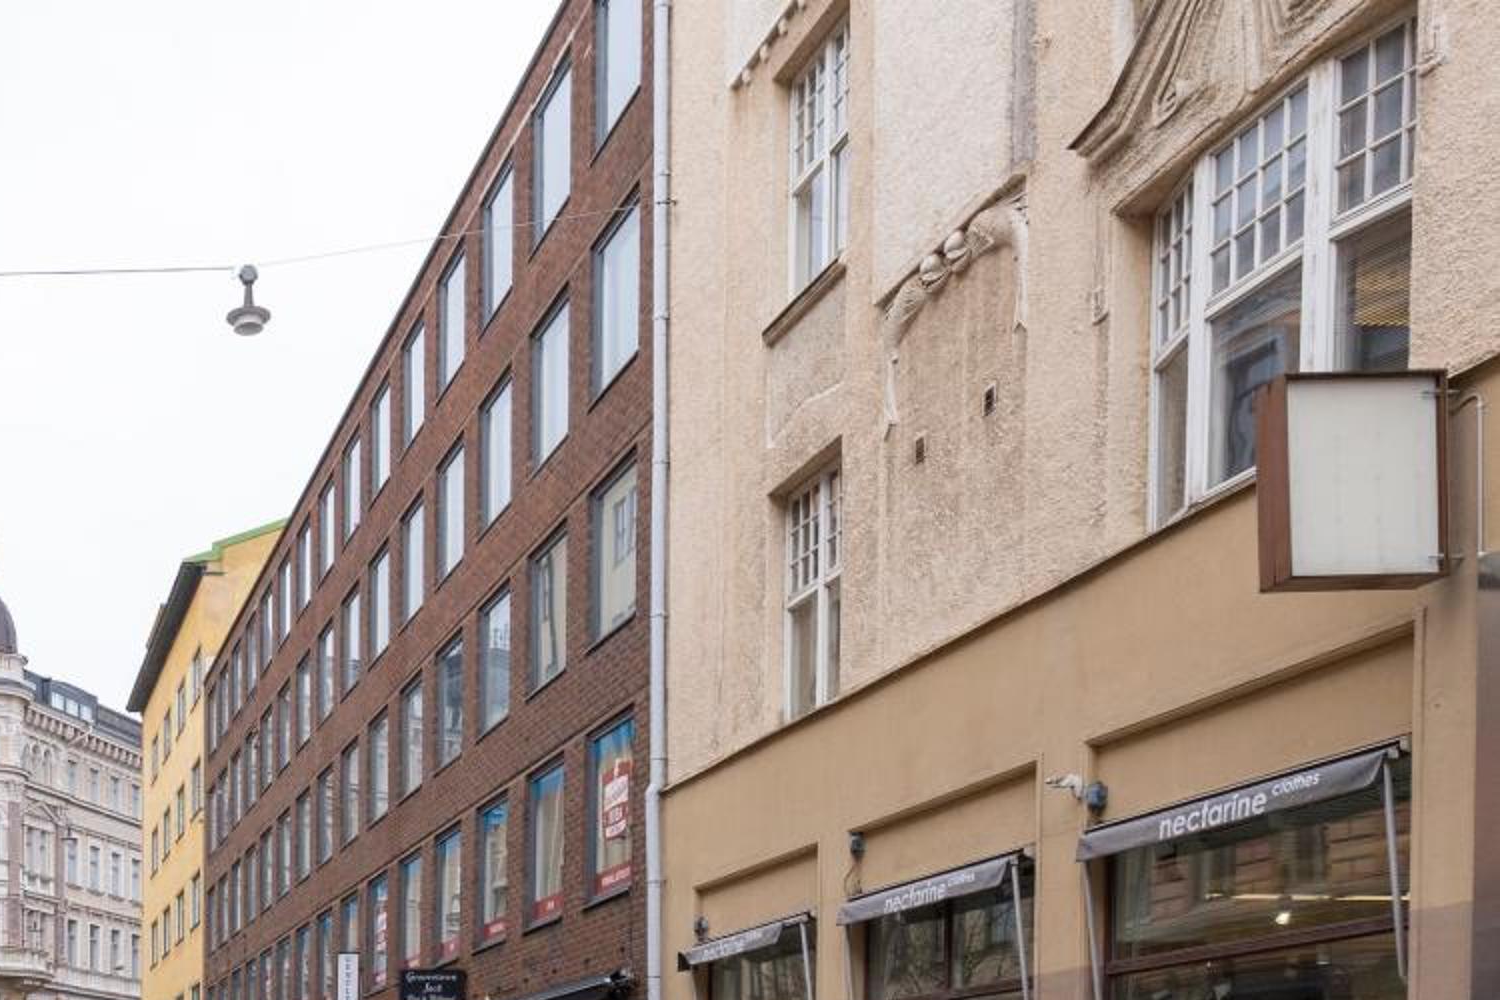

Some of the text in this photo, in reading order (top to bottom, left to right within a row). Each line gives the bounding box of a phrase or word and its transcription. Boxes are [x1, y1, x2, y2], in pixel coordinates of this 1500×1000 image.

[1158, 772, 1321, 841] nectarine clothes
[883, 881, 947, 914] nectarine
